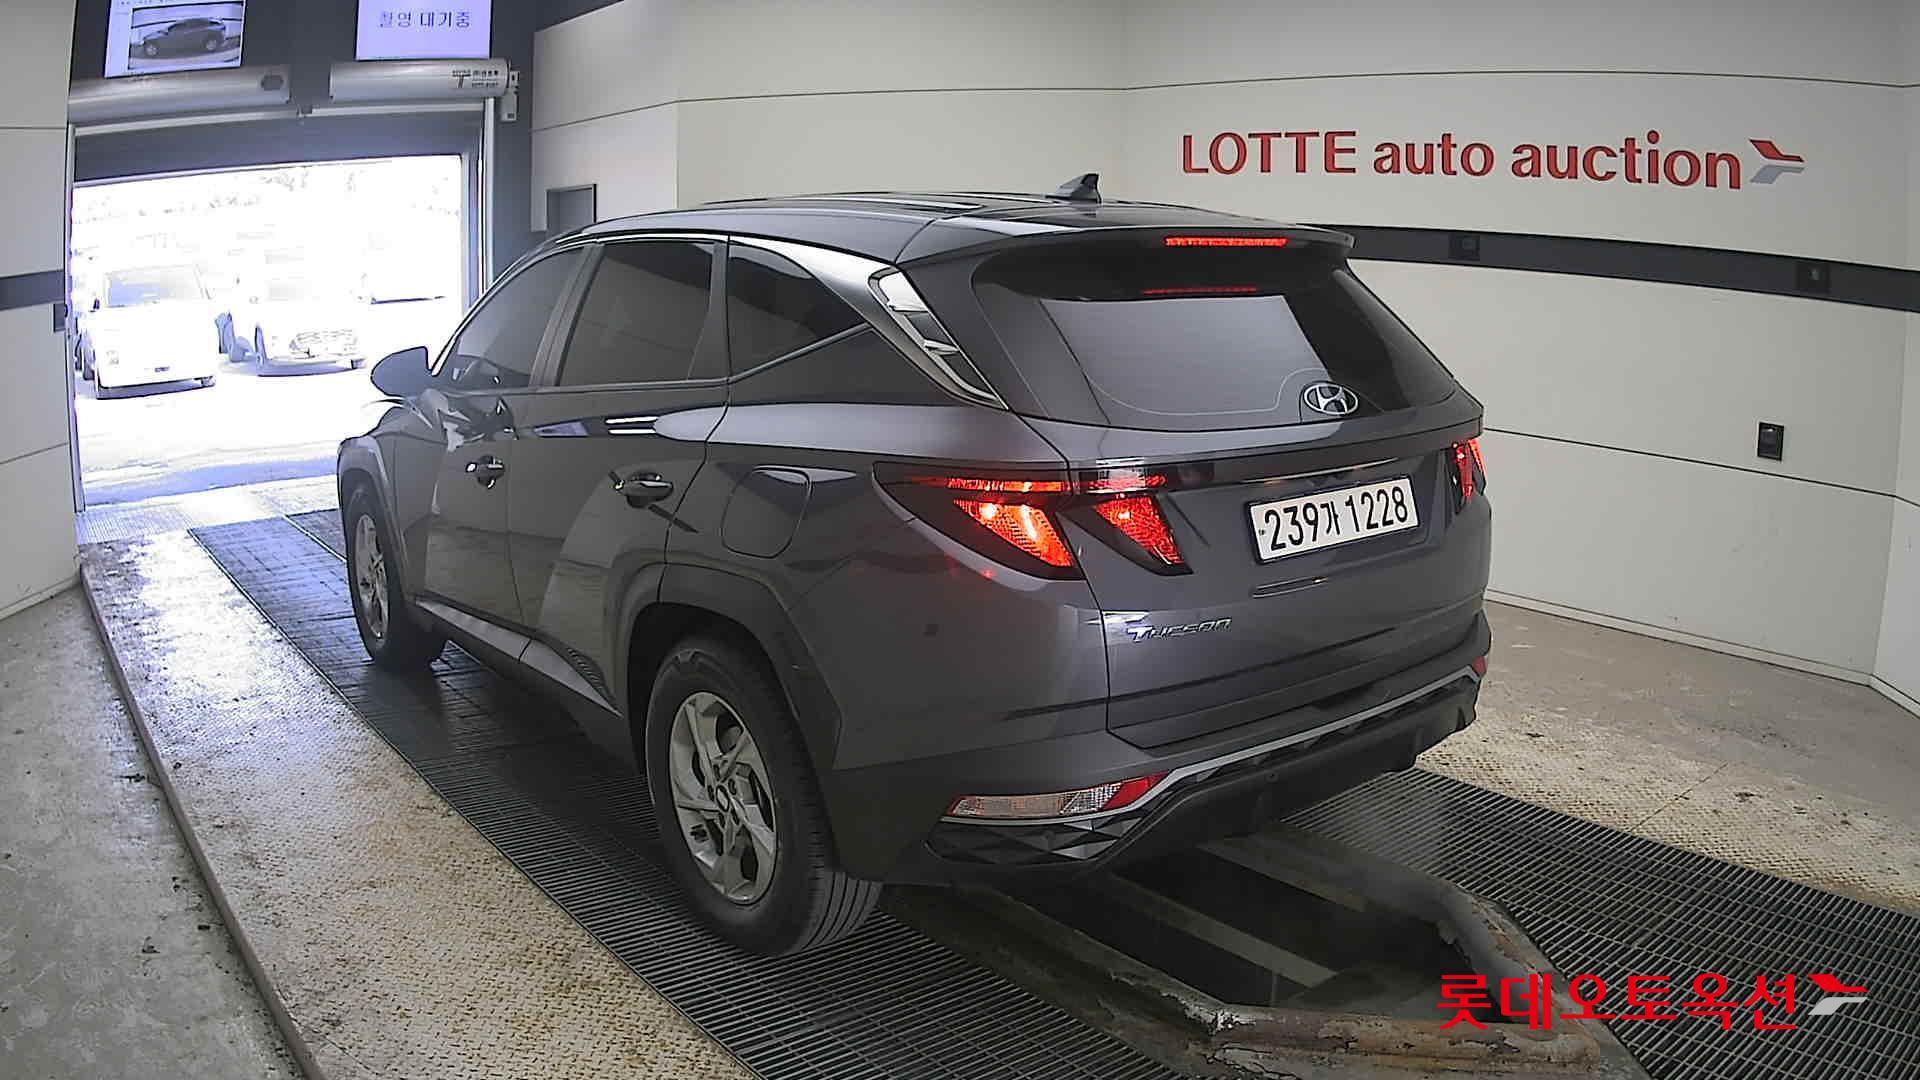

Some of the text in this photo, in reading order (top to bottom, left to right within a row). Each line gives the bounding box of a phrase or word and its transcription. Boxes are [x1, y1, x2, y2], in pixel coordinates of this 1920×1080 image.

[420, 12, 470, 28] 대기중
[1182, 131, 1740, 190] LOTTE auto auction
[1264, 486, 1409, 551] 239가 1228
